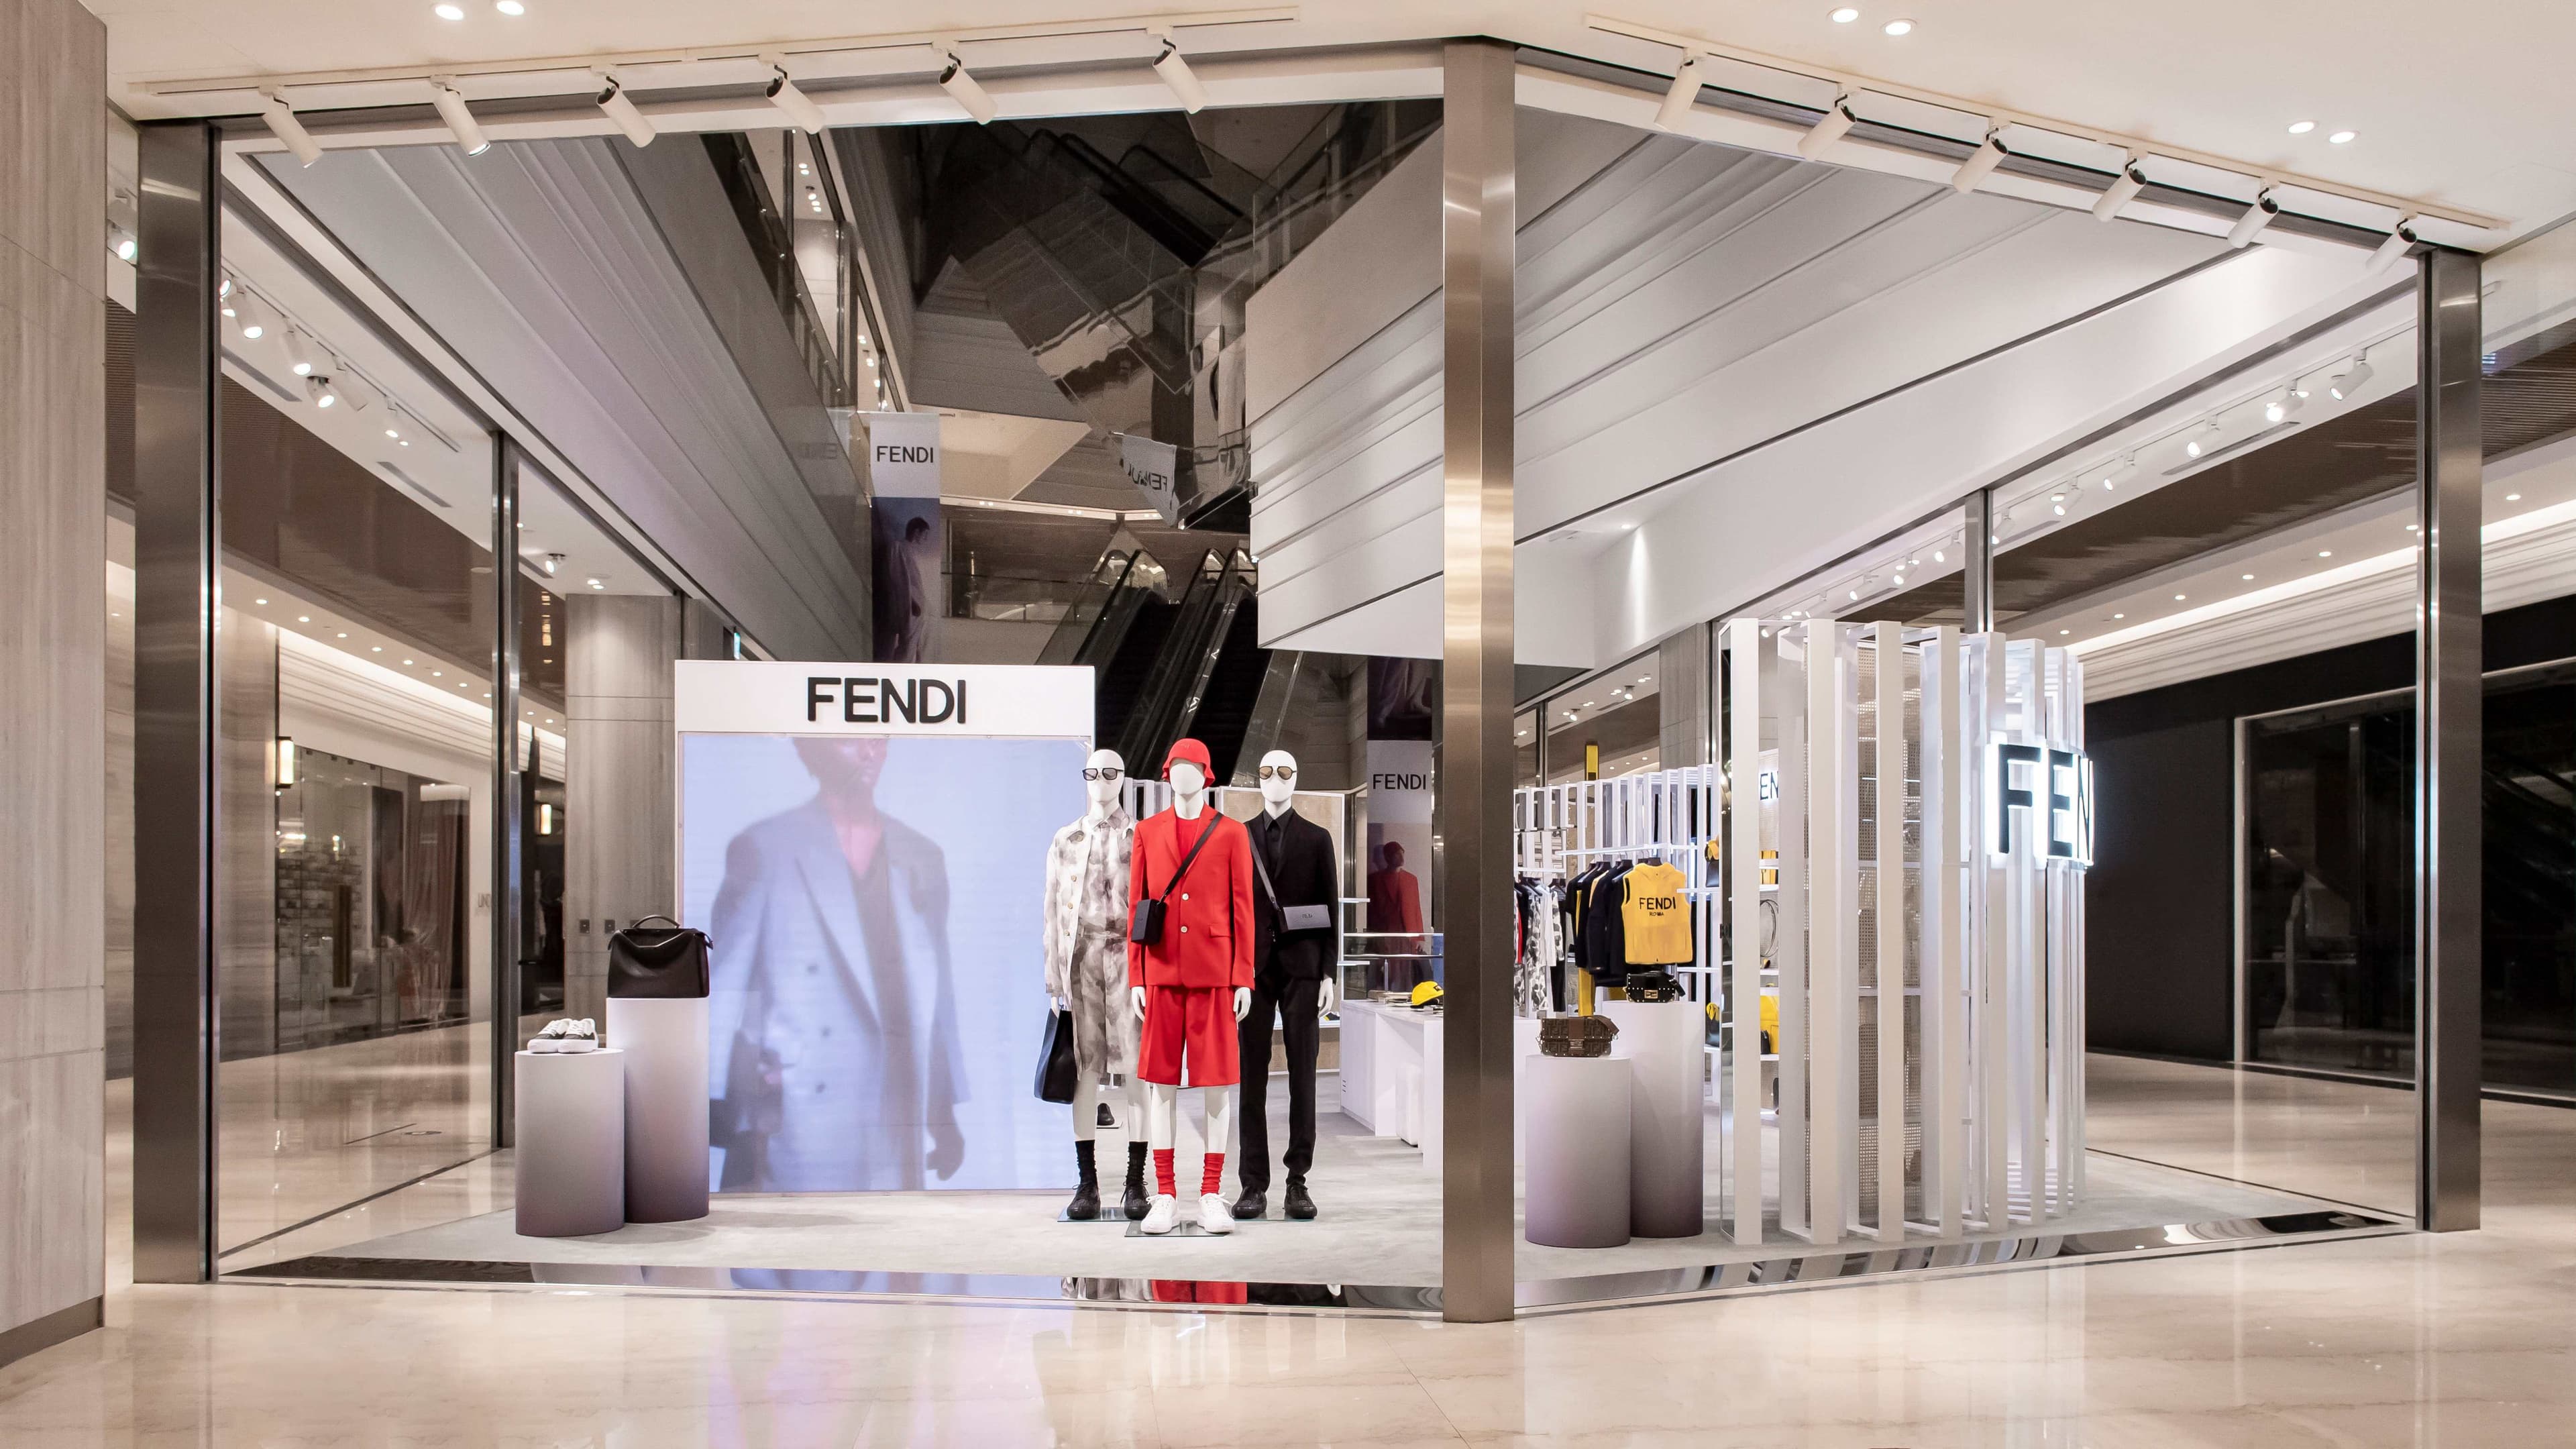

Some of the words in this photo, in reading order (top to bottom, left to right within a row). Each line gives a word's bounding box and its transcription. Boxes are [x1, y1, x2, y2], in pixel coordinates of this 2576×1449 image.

[877, 445, 933, 463] FENDI
[808, 676, 966, 723] FENDI
[1373, 773, 1426, 790] FENDI
[1639, 896, 1676, 910] FENDI
